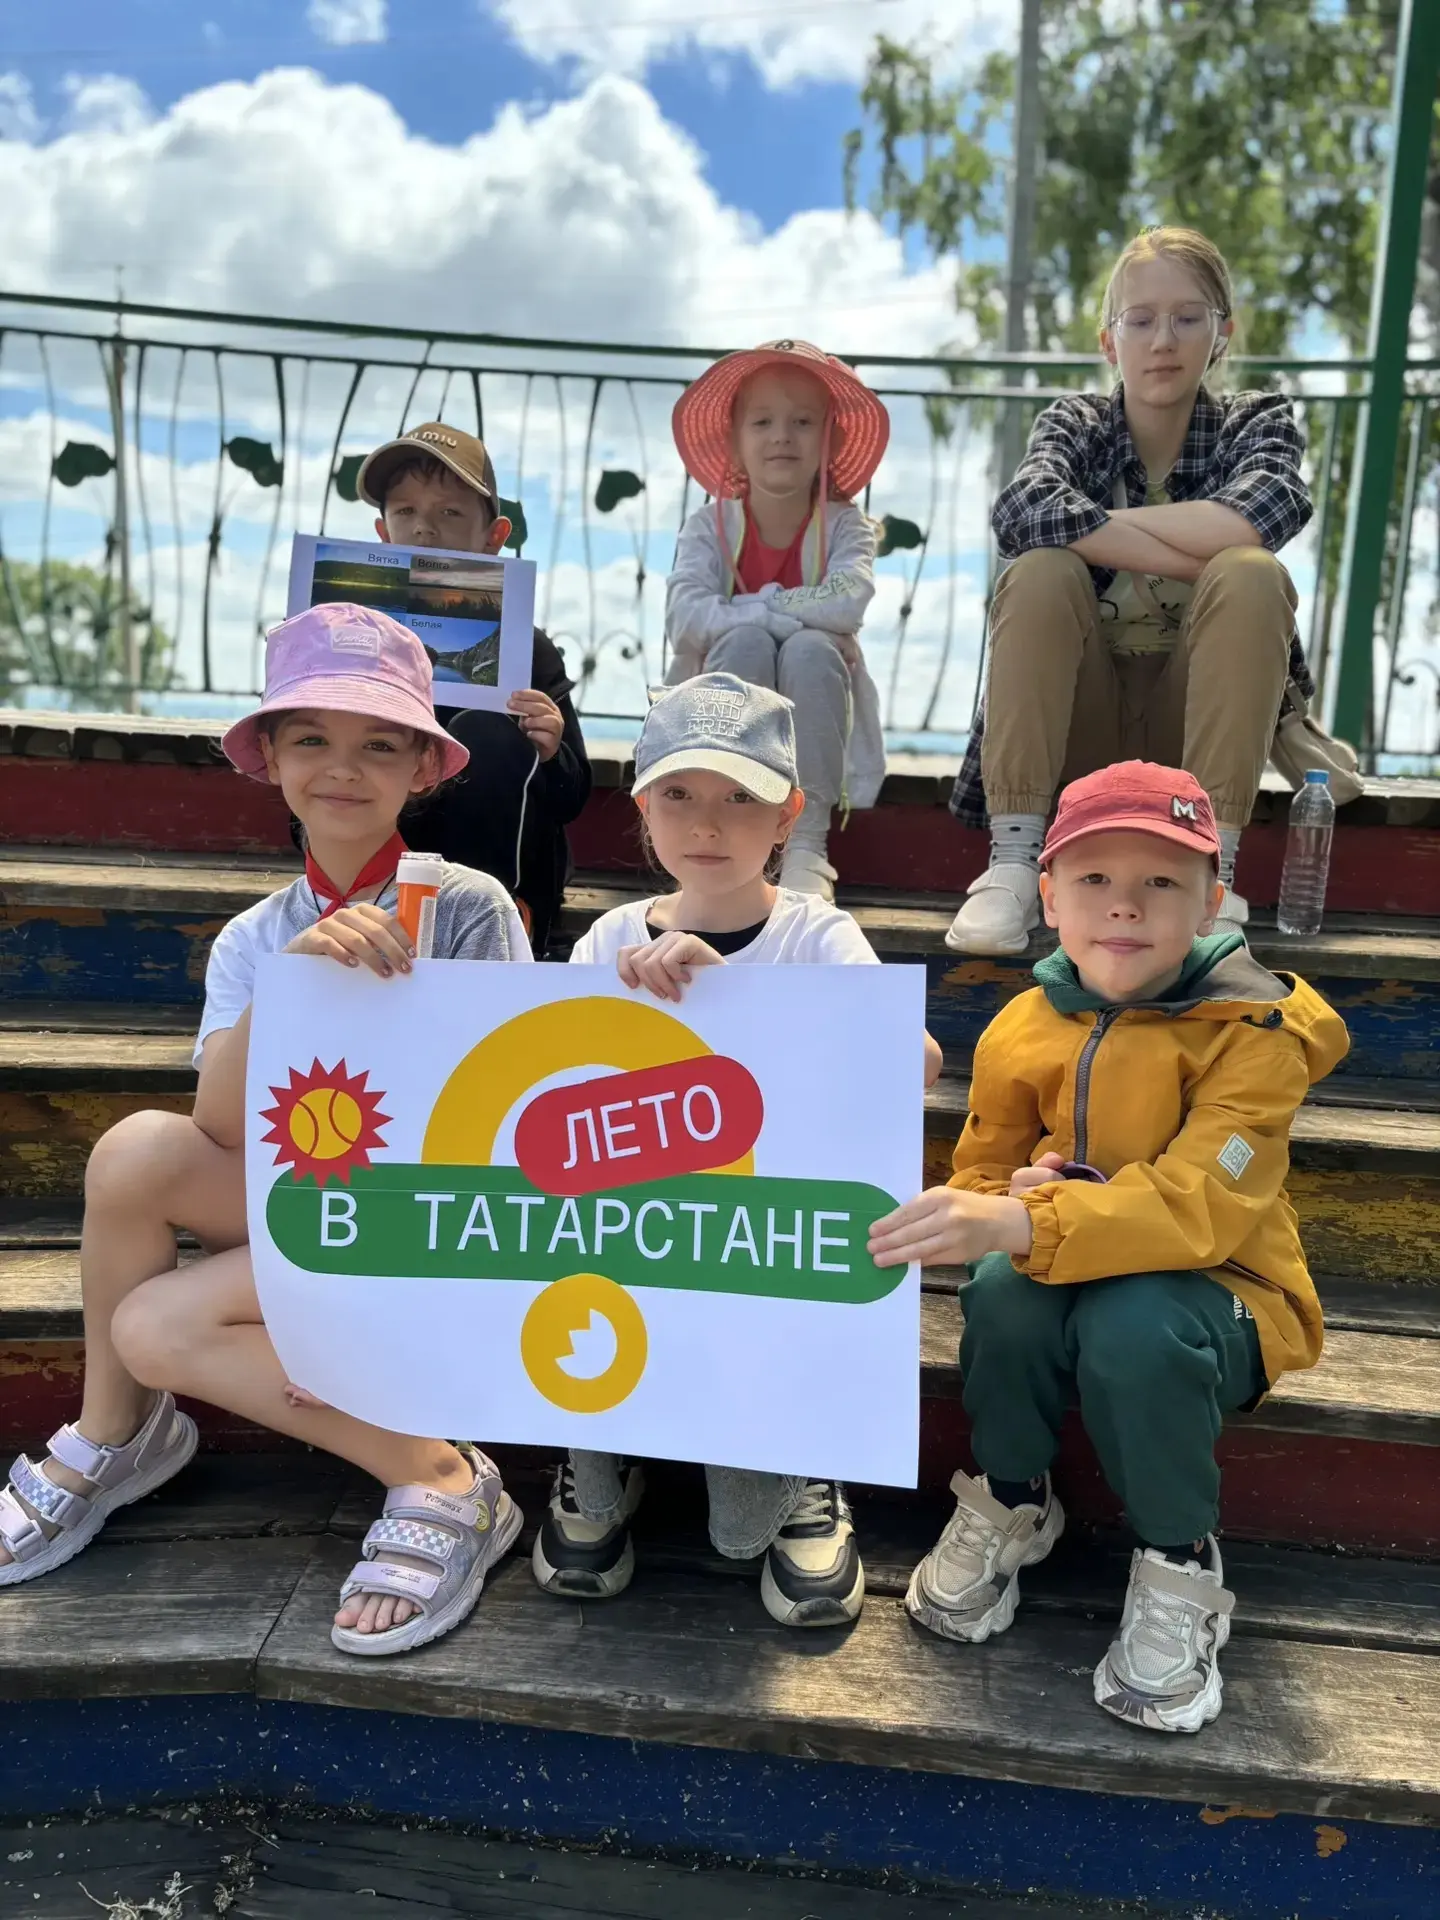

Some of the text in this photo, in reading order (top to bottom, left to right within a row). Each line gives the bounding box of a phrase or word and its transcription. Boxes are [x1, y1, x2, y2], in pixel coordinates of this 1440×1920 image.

[368, 553, 399, 565] Вятка
[417, 558, 450, 570] Волга
[411, 618, 443, 629] Белая
[692, 687, 746, 707] WILD
[690, 702, 742, 721] AND
[684, 717, 745, 738] FREE
[1171, 795, 1197, 822] M
[562, 1083, 723, 1170] ЛЕТО
[319, 1190, 851, 1274] В ТАТАРСТАНЕ
